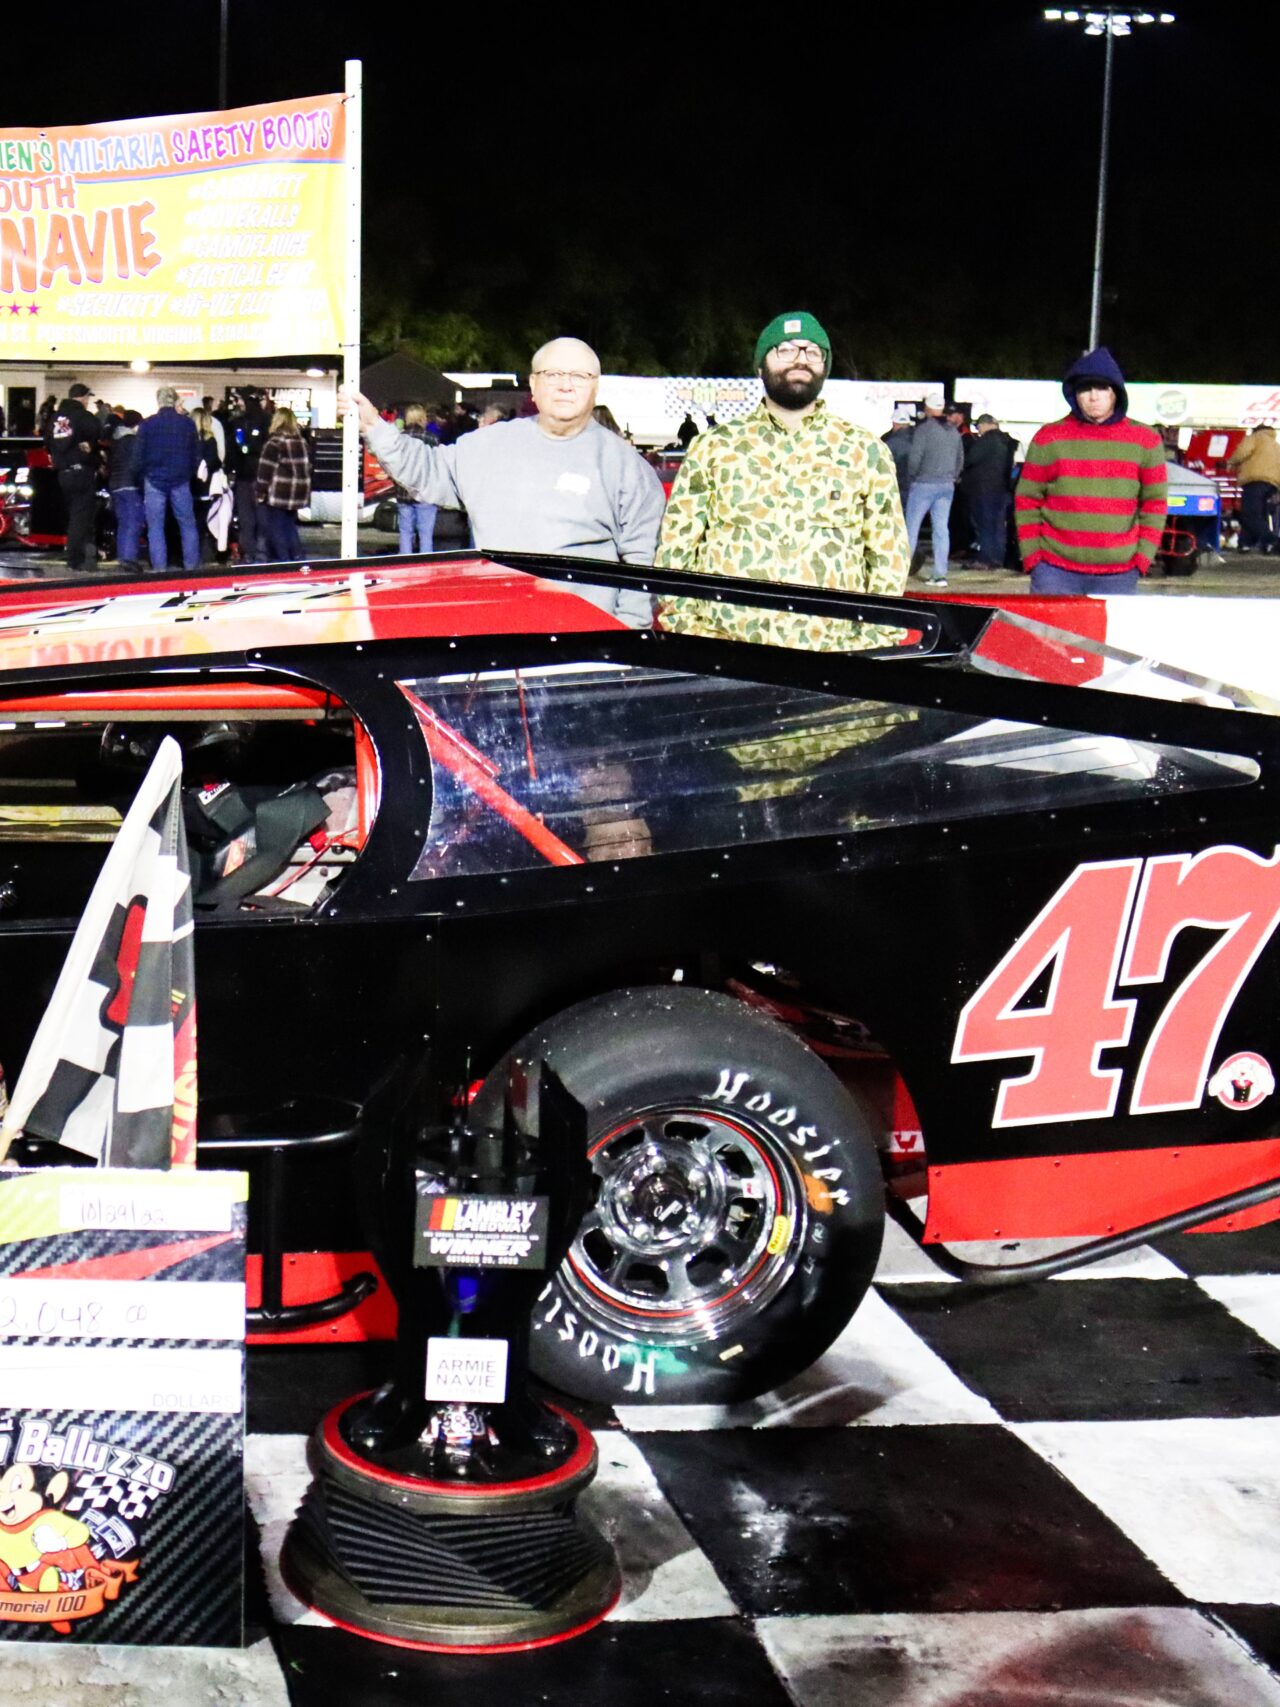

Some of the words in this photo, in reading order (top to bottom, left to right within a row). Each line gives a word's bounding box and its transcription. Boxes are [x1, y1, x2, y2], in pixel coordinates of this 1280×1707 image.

[59, 132, 168, 175] MILTARIA
[171, 120, 256, 164] SAFETY
[260, 110, 333, 150] BOOTS
[950, 845, 1280, 1129] 47
[455, 1200, 537, 1222] LANGLEY
[453, 1220, 531, 1233] SPEEDWAY
[430, 1238, 531, 1257] WINNER
[437, 1359, 497, 1374] ARMIE
[436, 1374, 496, 1388] NAVIE
[151, 1392, 235, 1409] DOLLARS
[16, 1420, 176, 1493] Balluzzo
[56, 1595, 87, 1612] 100
